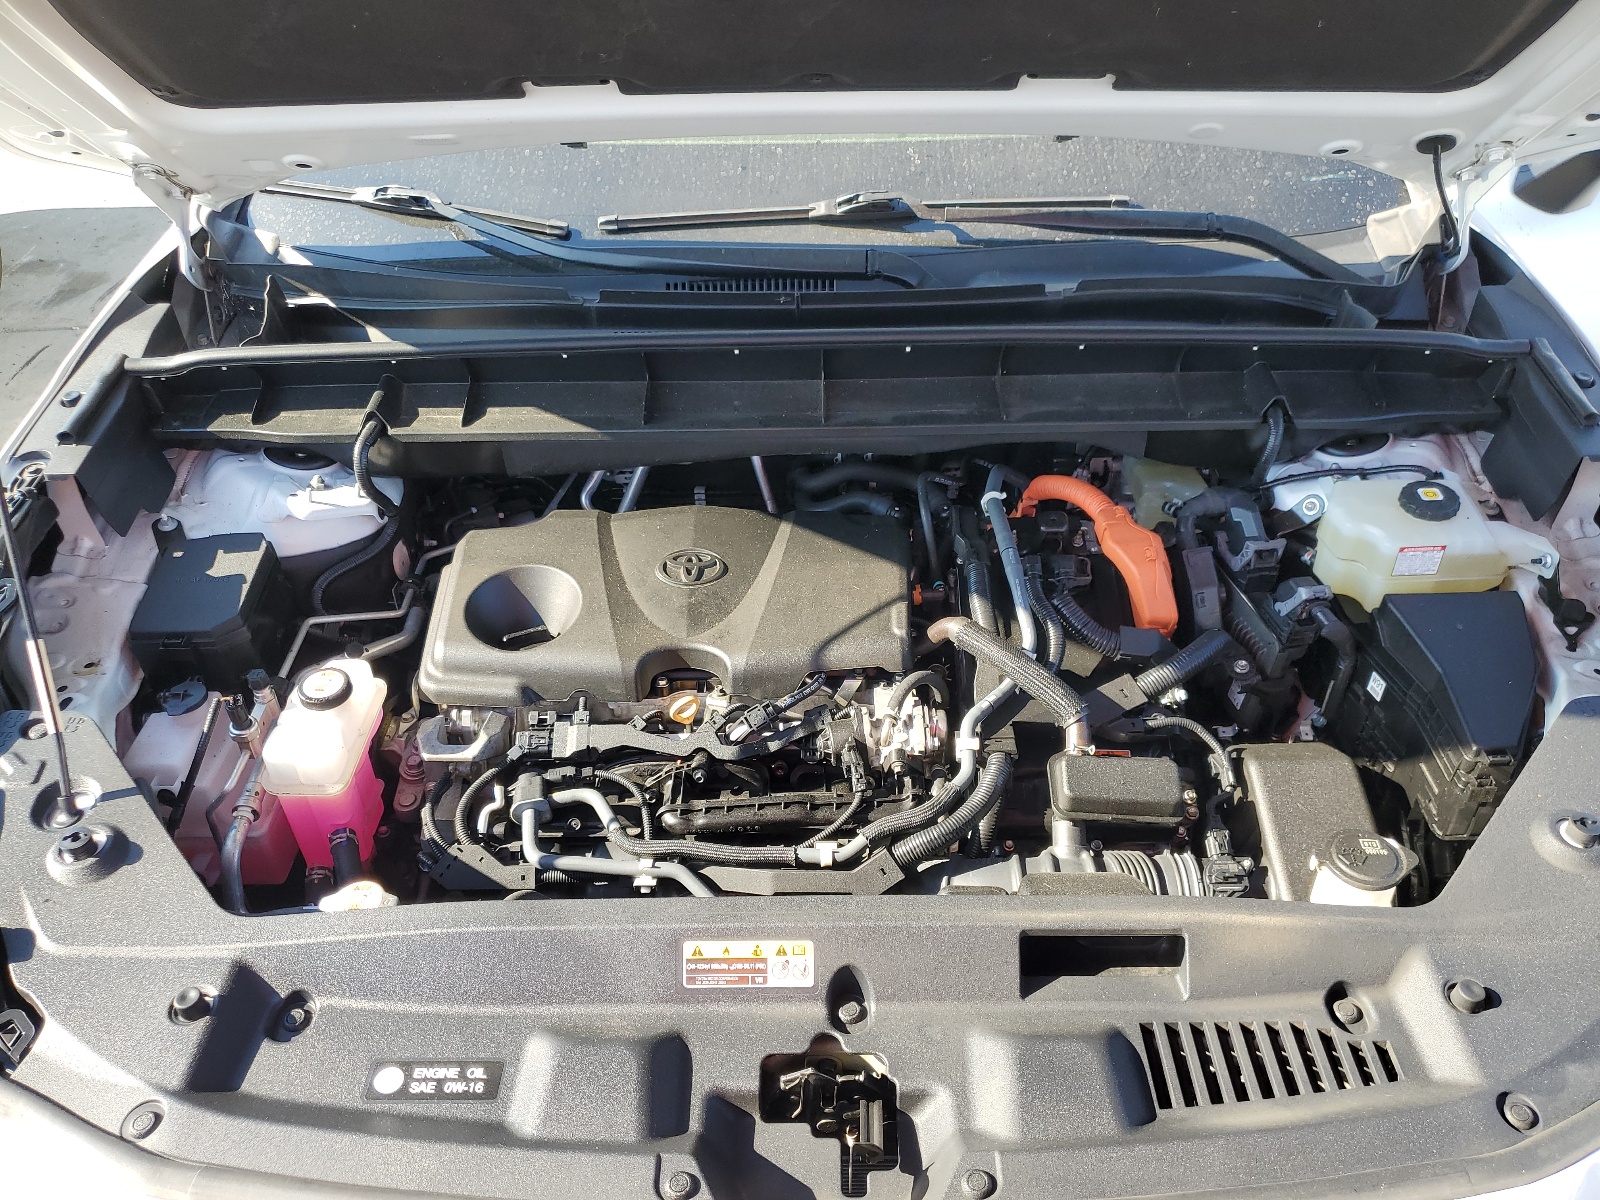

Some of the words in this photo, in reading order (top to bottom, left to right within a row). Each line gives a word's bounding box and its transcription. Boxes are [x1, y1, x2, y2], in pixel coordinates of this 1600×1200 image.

[413, 1067, 460, 1079] ENGINE
[466, 1067, 487, 1079] OIL
[409, 1081, 436, 1094] SAE
[443, 1081, 484, 1094] 0W-16
